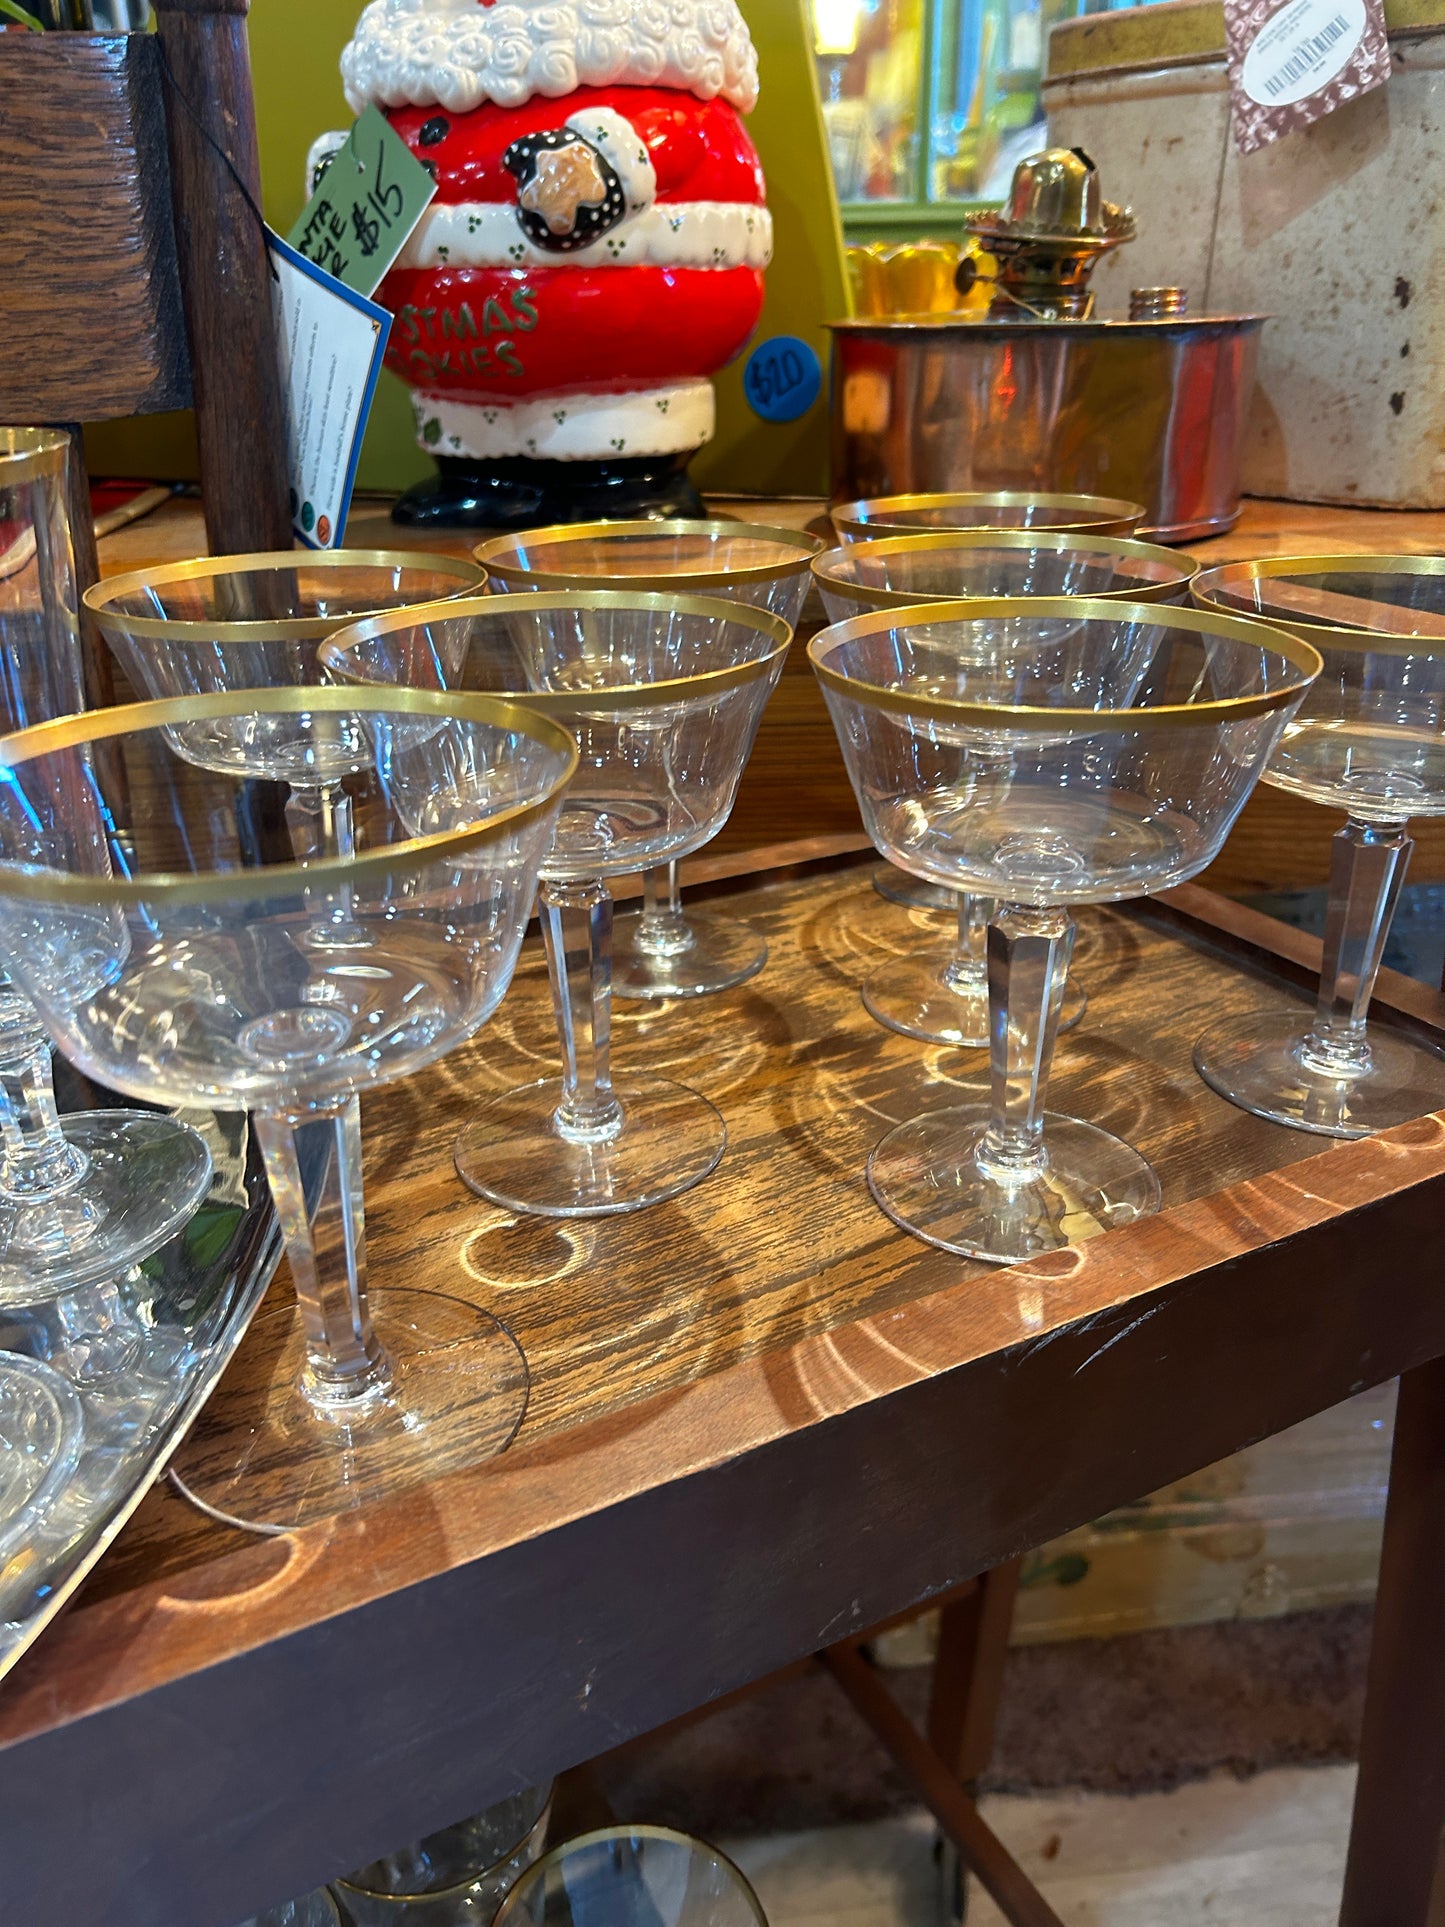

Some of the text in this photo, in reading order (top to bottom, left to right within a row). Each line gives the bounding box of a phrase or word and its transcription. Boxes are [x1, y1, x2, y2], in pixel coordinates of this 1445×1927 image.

[352, 139, 404, 257] $15
[297, 199, 334, 256] NTA
[312, 211, 348, 266] KIE
[330, 251, 350, 279] R
[400, 287, 539, 345] STMAS
